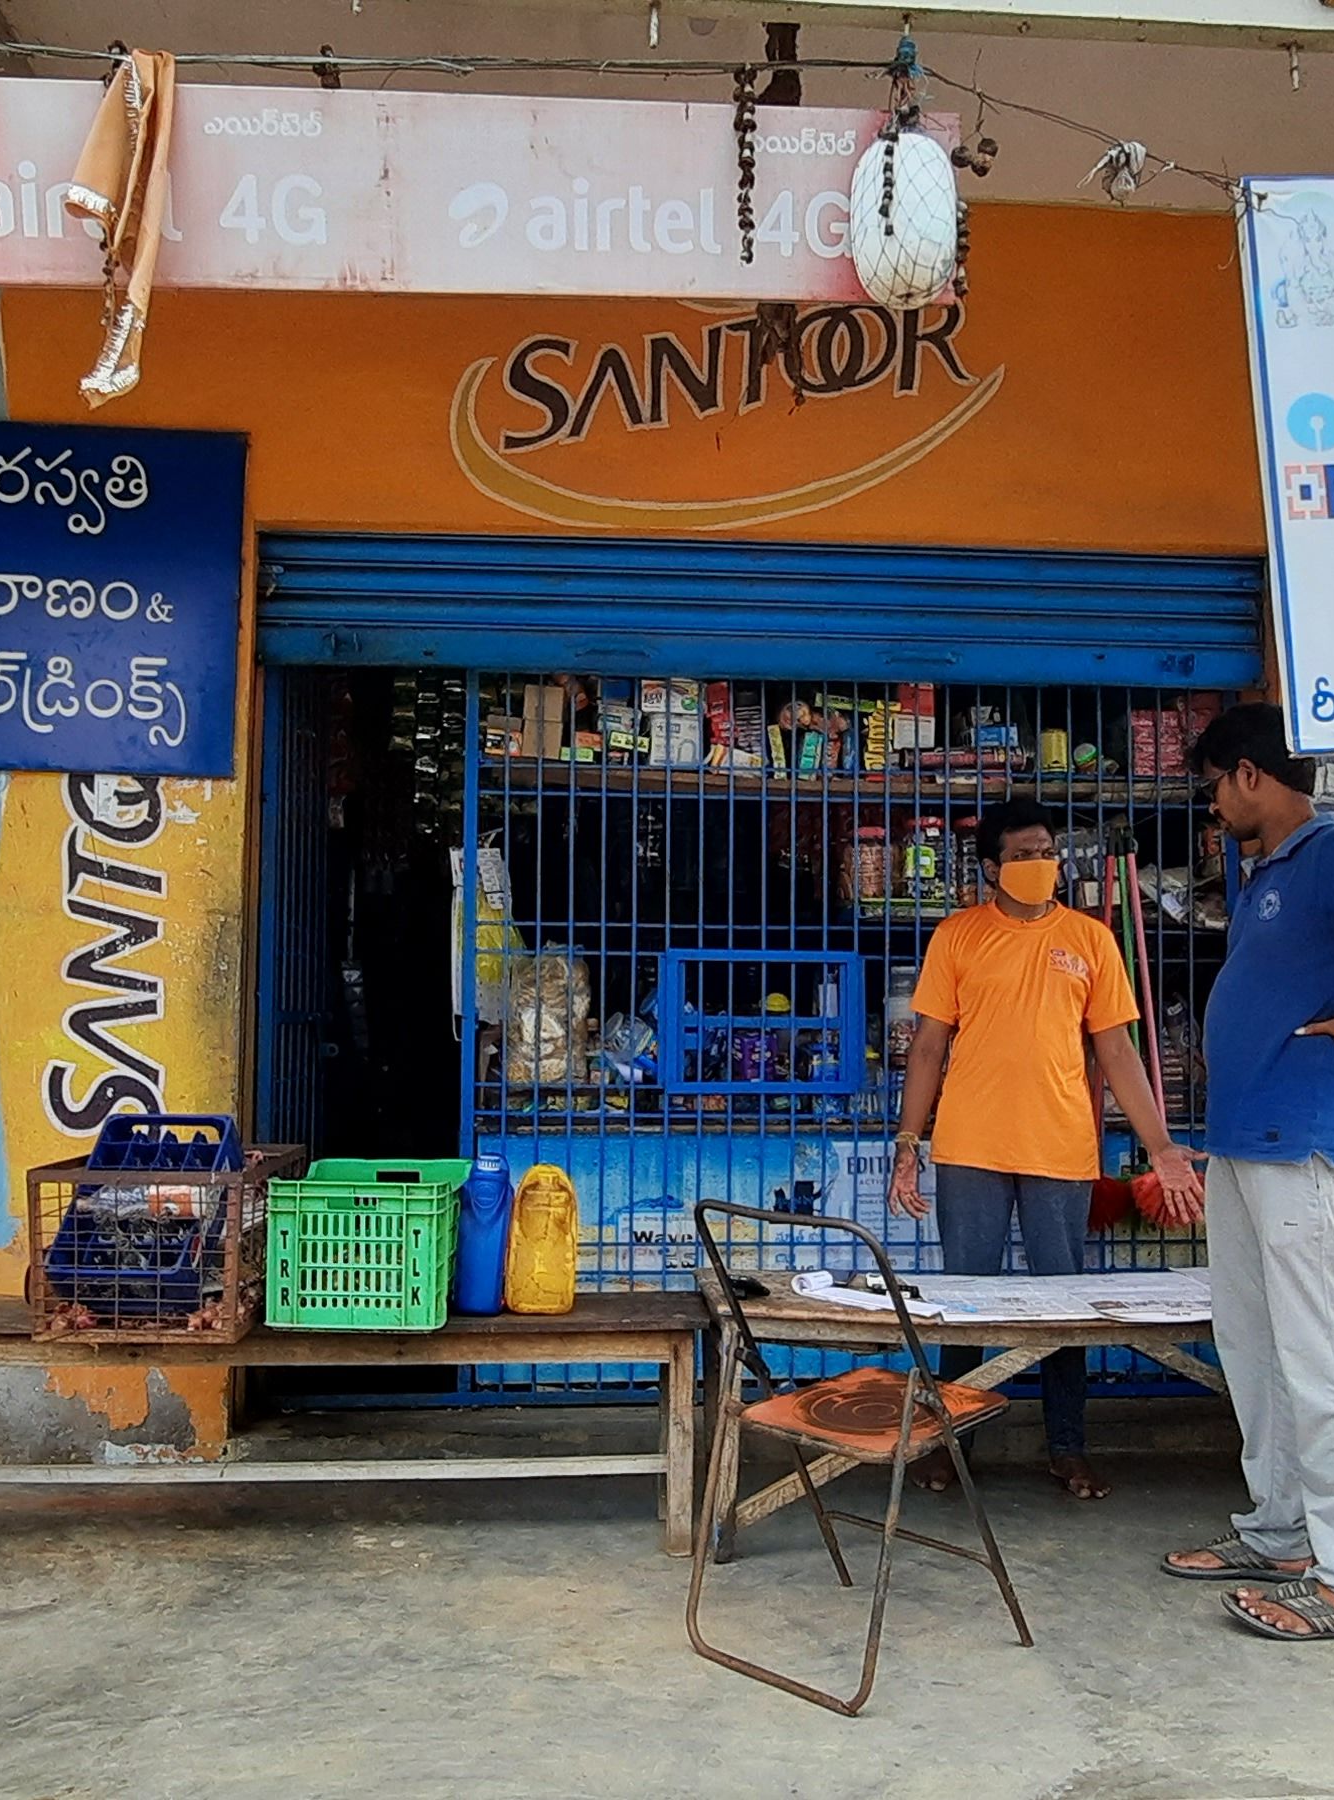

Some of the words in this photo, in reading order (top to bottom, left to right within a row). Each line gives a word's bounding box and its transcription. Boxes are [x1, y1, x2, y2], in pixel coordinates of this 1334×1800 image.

[218, 172, 328, 246] 4G
[525, 177, 721, 256] airtel
[755, 190, 853, 259] 4G
[145, 592, 174, 623] &
[847, 1154, 926, 1175] EDITIS
